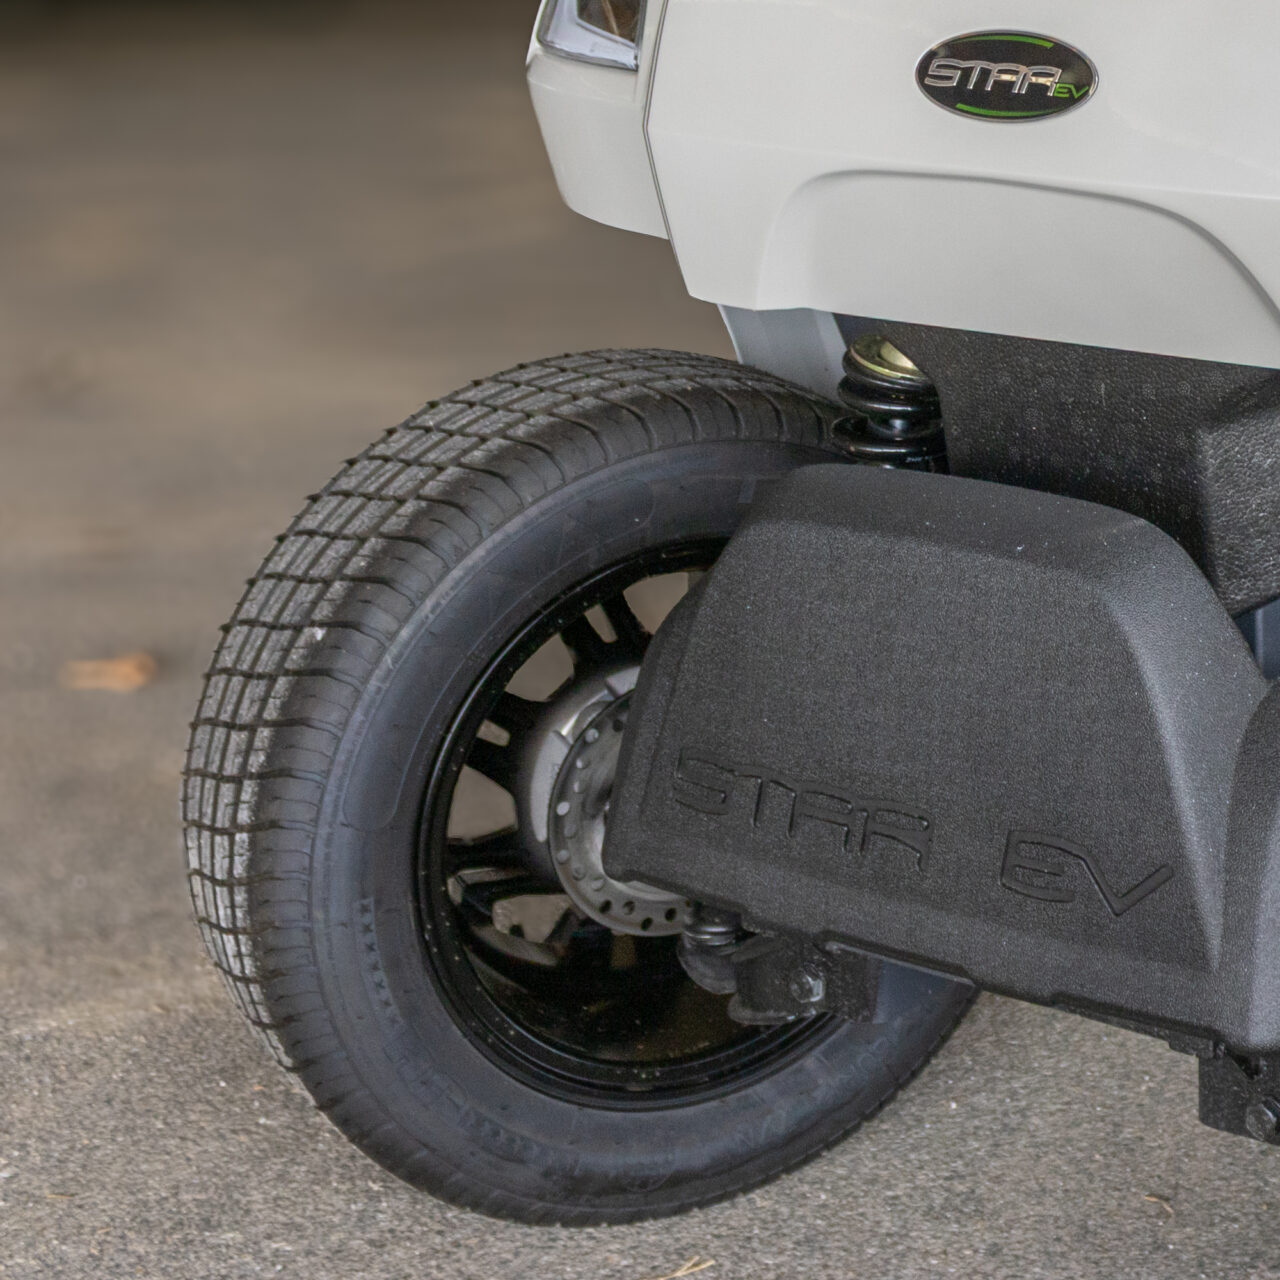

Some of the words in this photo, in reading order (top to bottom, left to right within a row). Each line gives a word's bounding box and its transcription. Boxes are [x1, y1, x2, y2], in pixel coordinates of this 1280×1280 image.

[924, 58, 1062, 97] STAR
[1054, 83, 1089, 99] EV
[673, 747, 932, 872] STAR
[1001, 828, 1173, 916] EV
